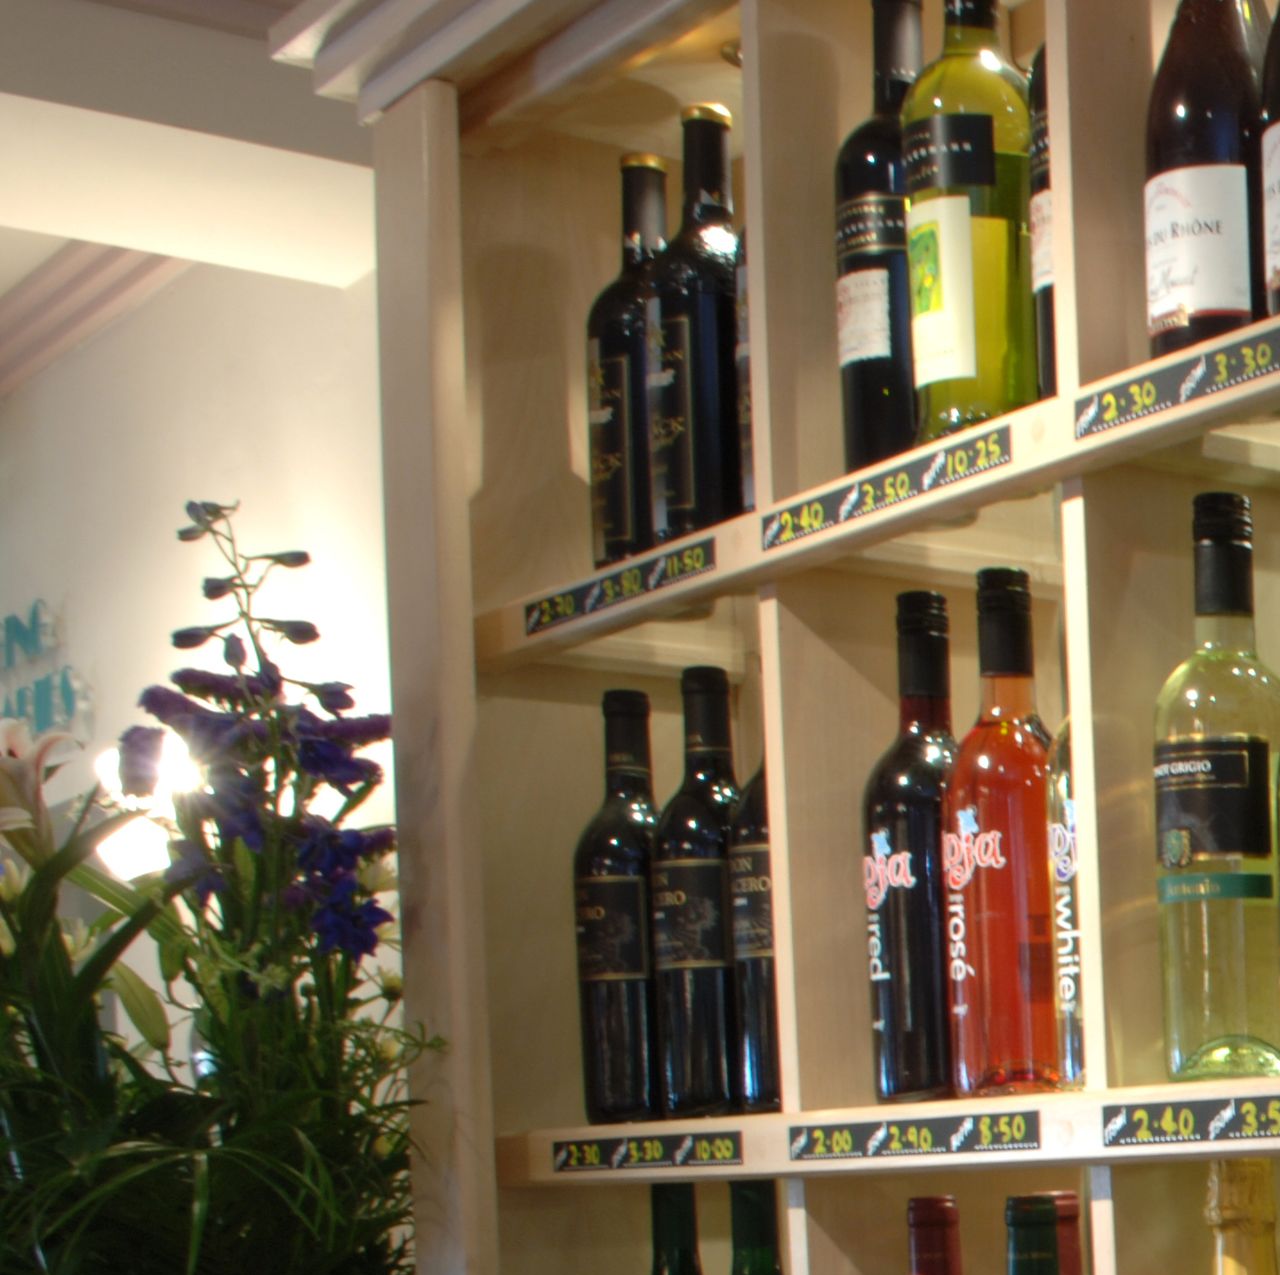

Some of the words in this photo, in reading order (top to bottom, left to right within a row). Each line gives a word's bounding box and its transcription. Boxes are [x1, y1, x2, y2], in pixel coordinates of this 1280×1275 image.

[1214, 343, 1272, 384] 3.30
[1102, 380, 1157, 422] 2.30
[812, 1128, 852, 1154] 2.00
[889, 1125, 932, 1151] 2.90
[979, 1114, 1026, 1146] 8.50
[1132, 1105, 1195, 1141] 2.40
